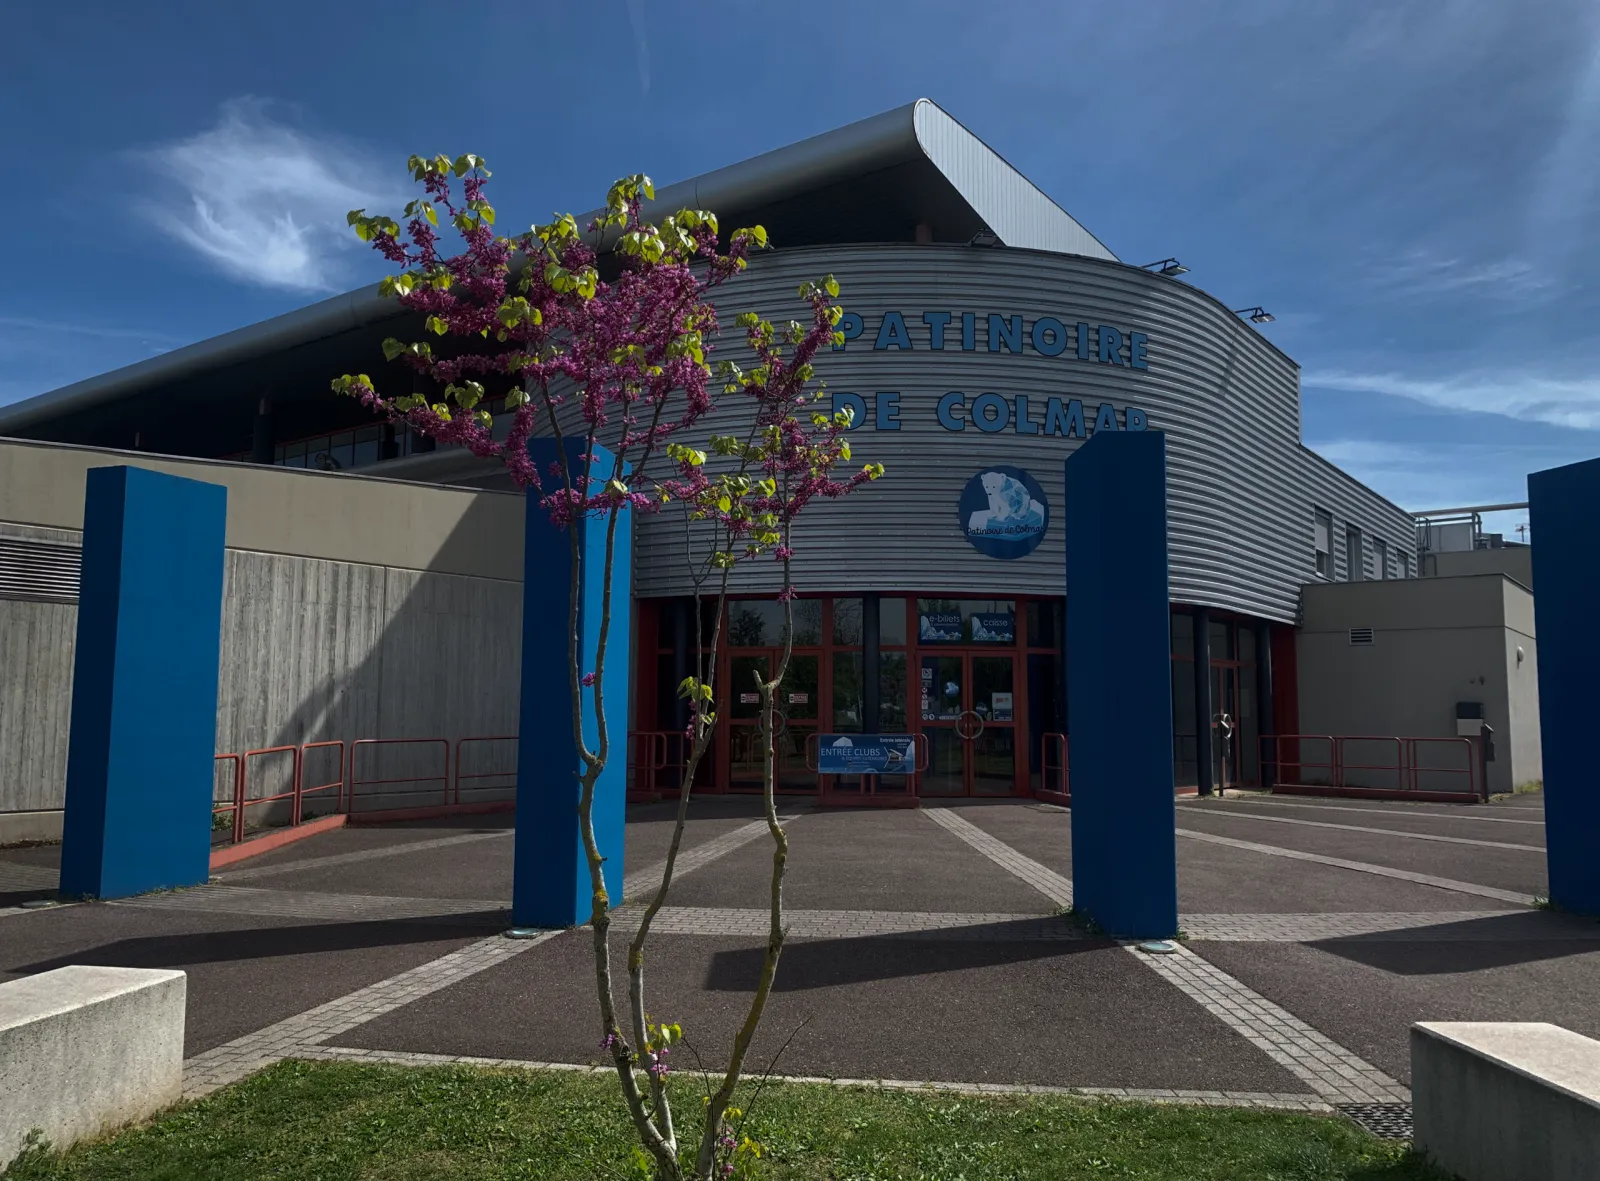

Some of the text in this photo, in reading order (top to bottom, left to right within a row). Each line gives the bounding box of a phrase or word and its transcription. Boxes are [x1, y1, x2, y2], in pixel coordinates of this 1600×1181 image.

[831, 311, 1148, 371] PATINOIRE
[831, 391, 901, 431] DE
[966, 524, 1044, 536] Patinoire de Colmar
[929, 614, 960, 623] e-billets
[983, 618, 1008, 626] caisse
[820, 746, 880, 756] ENTRÉE CLUBS
